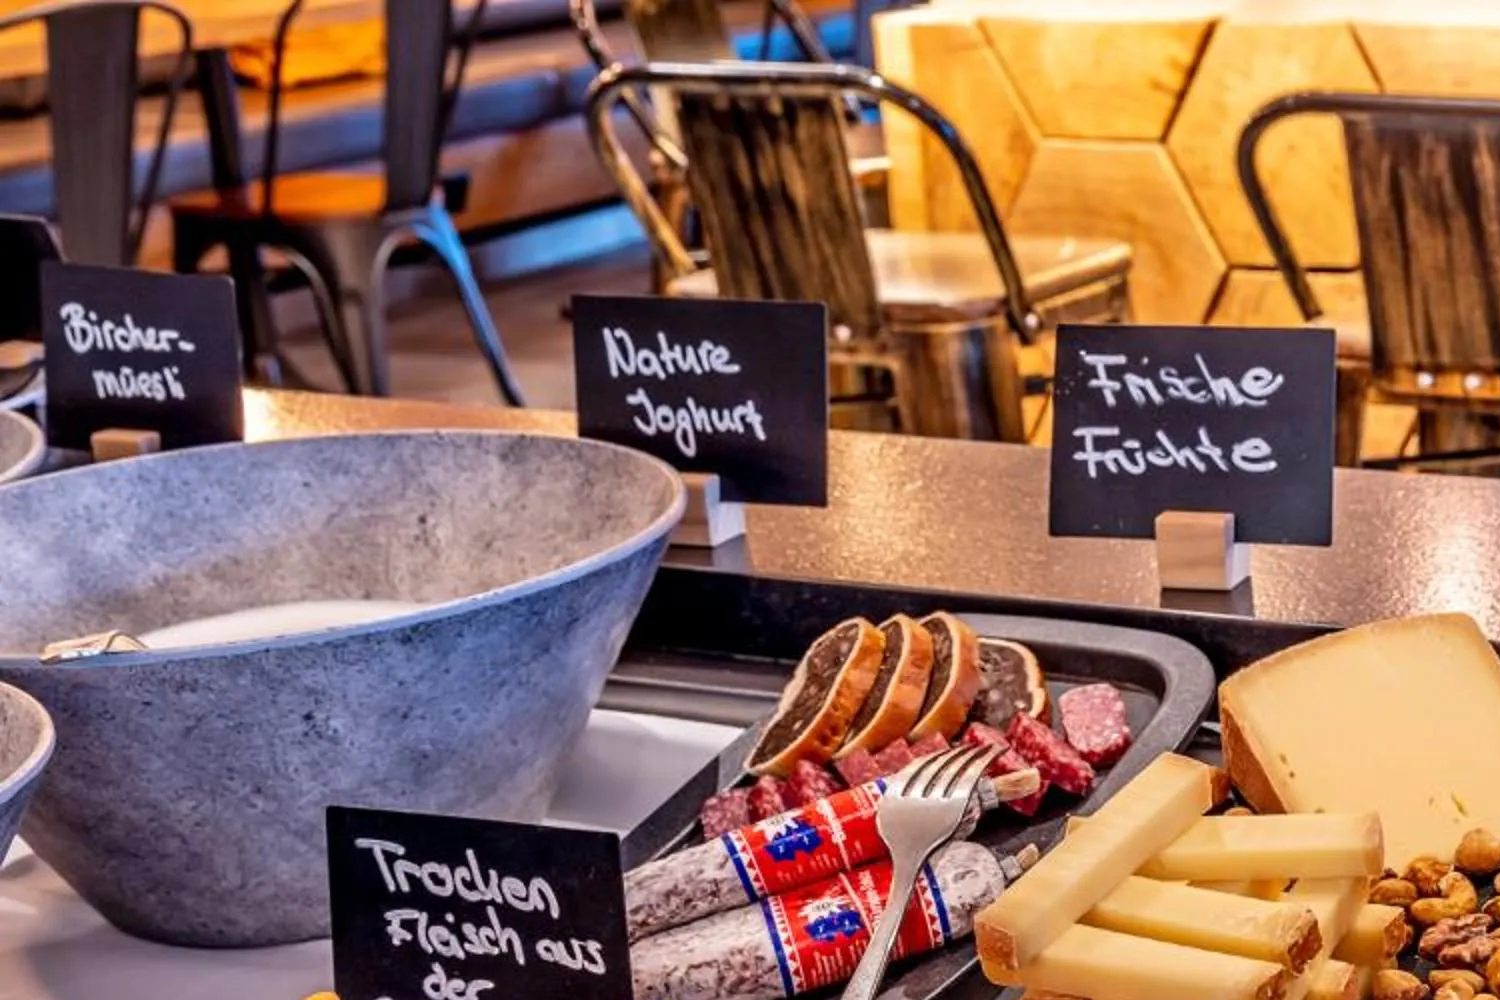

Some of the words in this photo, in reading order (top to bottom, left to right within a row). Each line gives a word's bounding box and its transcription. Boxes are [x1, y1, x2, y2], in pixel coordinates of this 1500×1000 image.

[59, 301, 196, 354] Bircher-
[602, 326, 742, 381] Nature
[1078, 349, 1285, 407] Frische
[625, 387, 768, 459] Joghurt
[1071, 425, 1279, 480] Früchte
[353, 837, 561, 919] Trocken
[383, 904, 526, 966] Fleisch
[535, 938, 607, 975] aus
